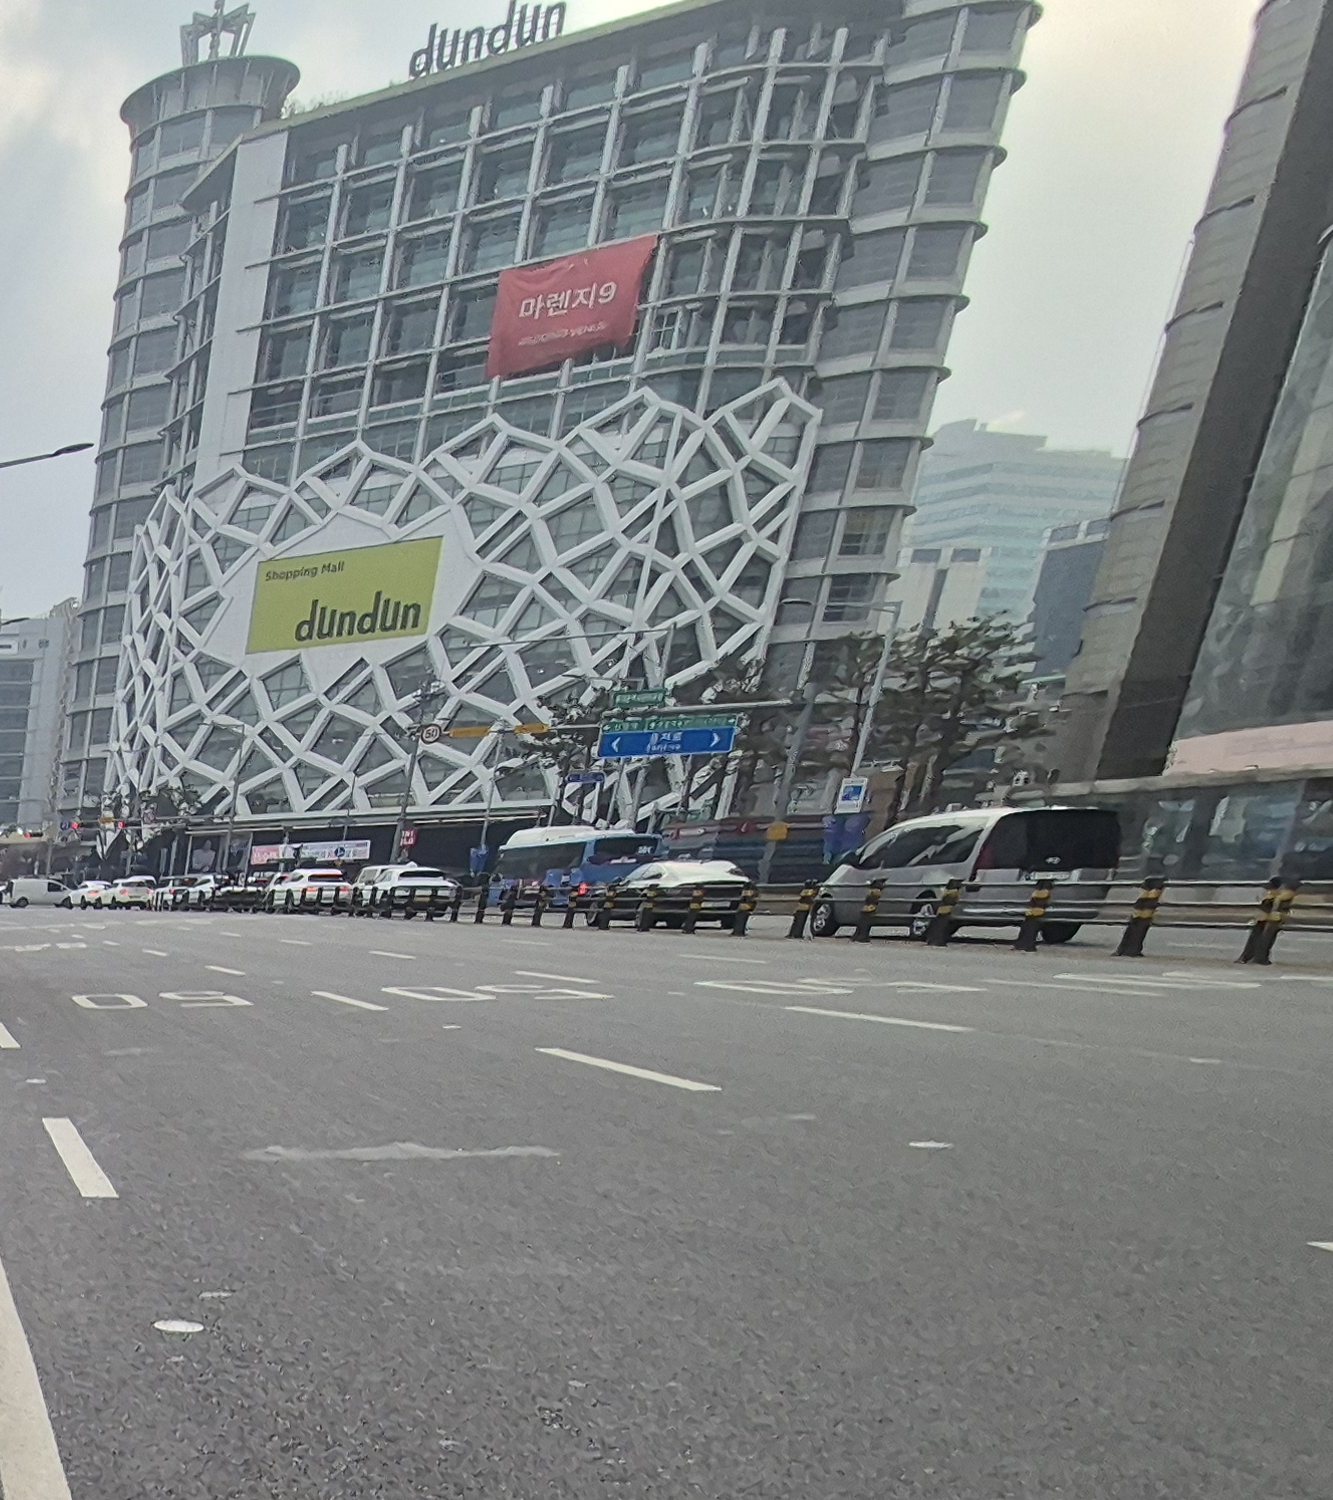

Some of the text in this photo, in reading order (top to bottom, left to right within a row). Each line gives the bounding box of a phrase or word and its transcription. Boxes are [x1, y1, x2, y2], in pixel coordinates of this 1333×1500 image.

[409, 0, 566, 78] dundun
[265, 561, 345, 582] Shopping Mall
[295, 591, 422, 642] dundun
